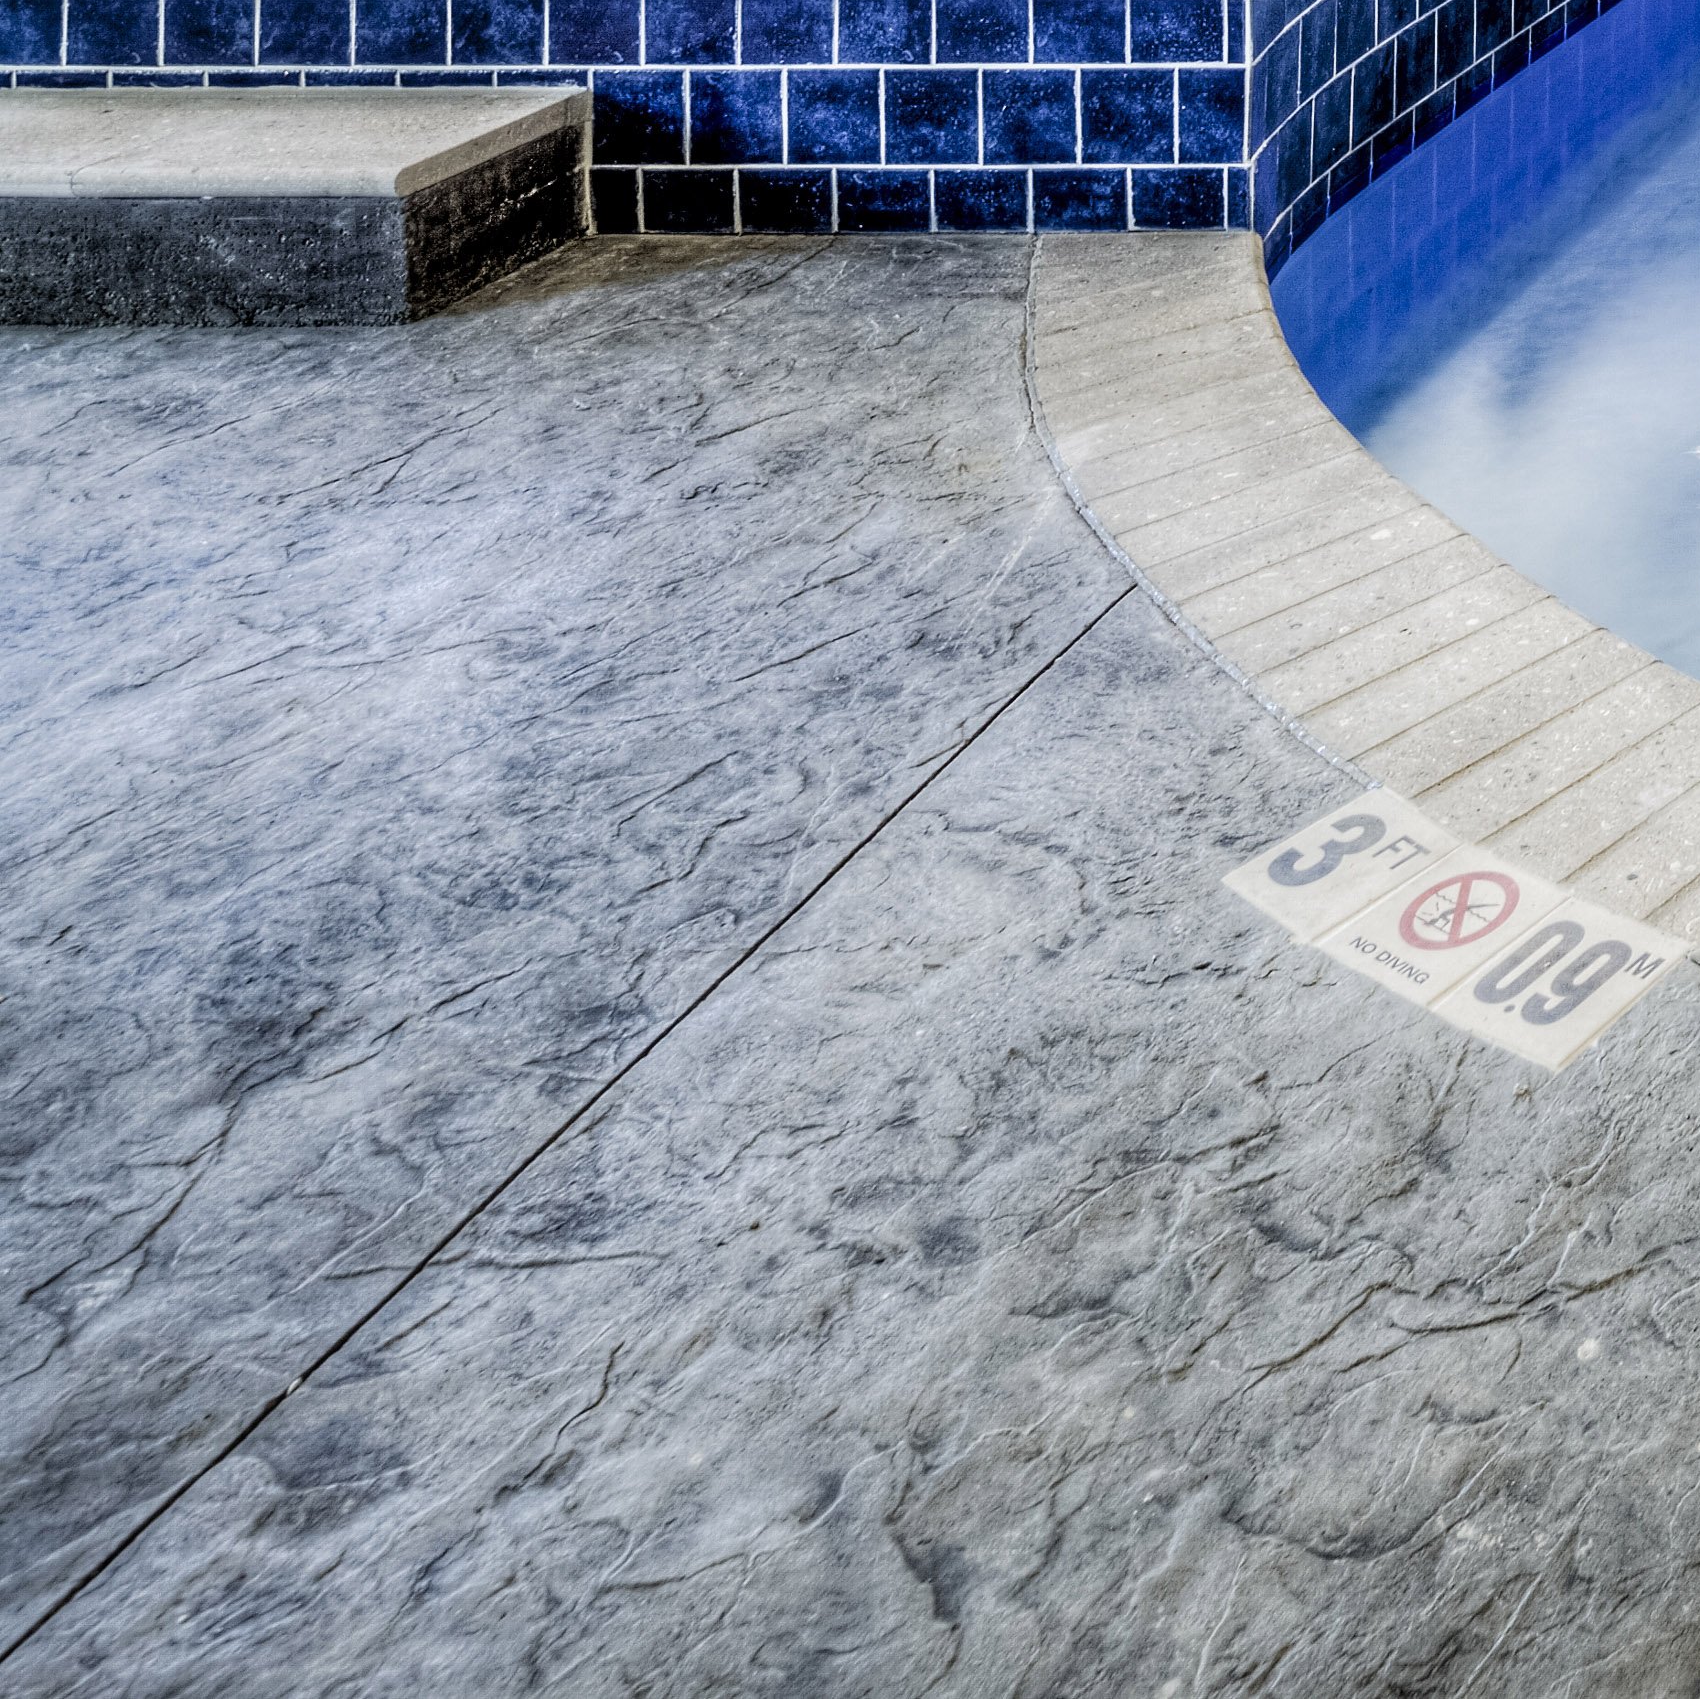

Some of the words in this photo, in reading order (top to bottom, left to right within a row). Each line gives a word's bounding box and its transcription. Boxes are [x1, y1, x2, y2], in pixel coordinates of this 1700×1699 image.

[1268, 814, 1387, 887] 3
[1374, 835, 1432, 870] FT
[1349, 936, 1378, 954] NO
[1376, 950, 1430, 984] DIVING
[1473, 920, 1633, 1027] 0.9
[1624, 952, 1667, 981] M
